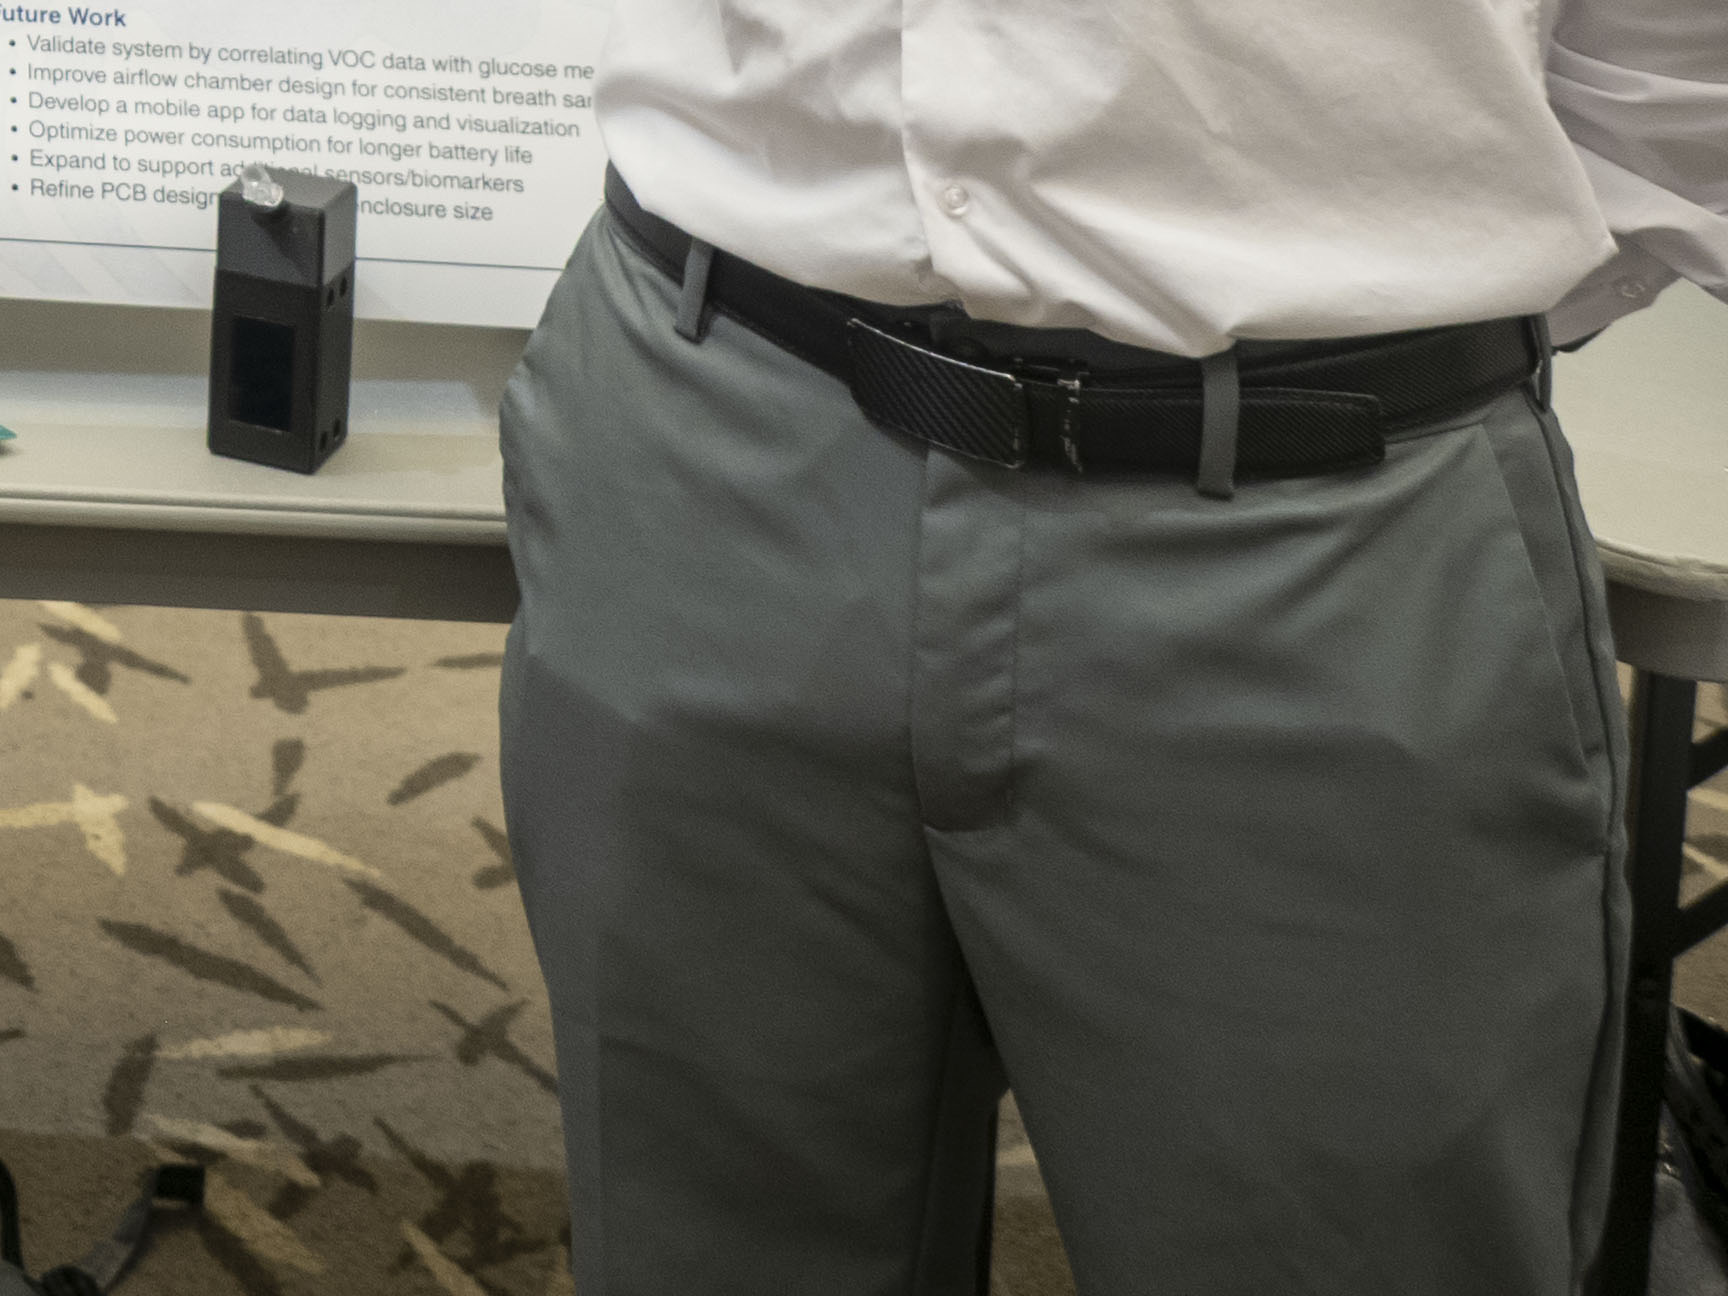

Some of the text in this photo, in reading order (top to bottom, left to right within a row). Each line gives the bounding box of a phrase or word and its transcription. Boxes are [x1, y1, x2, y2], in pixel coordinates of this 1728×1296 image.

[67, 6, 126, 27] Work
[28, 90, 581, 138] Develop a mobile app for data logging and visualization
